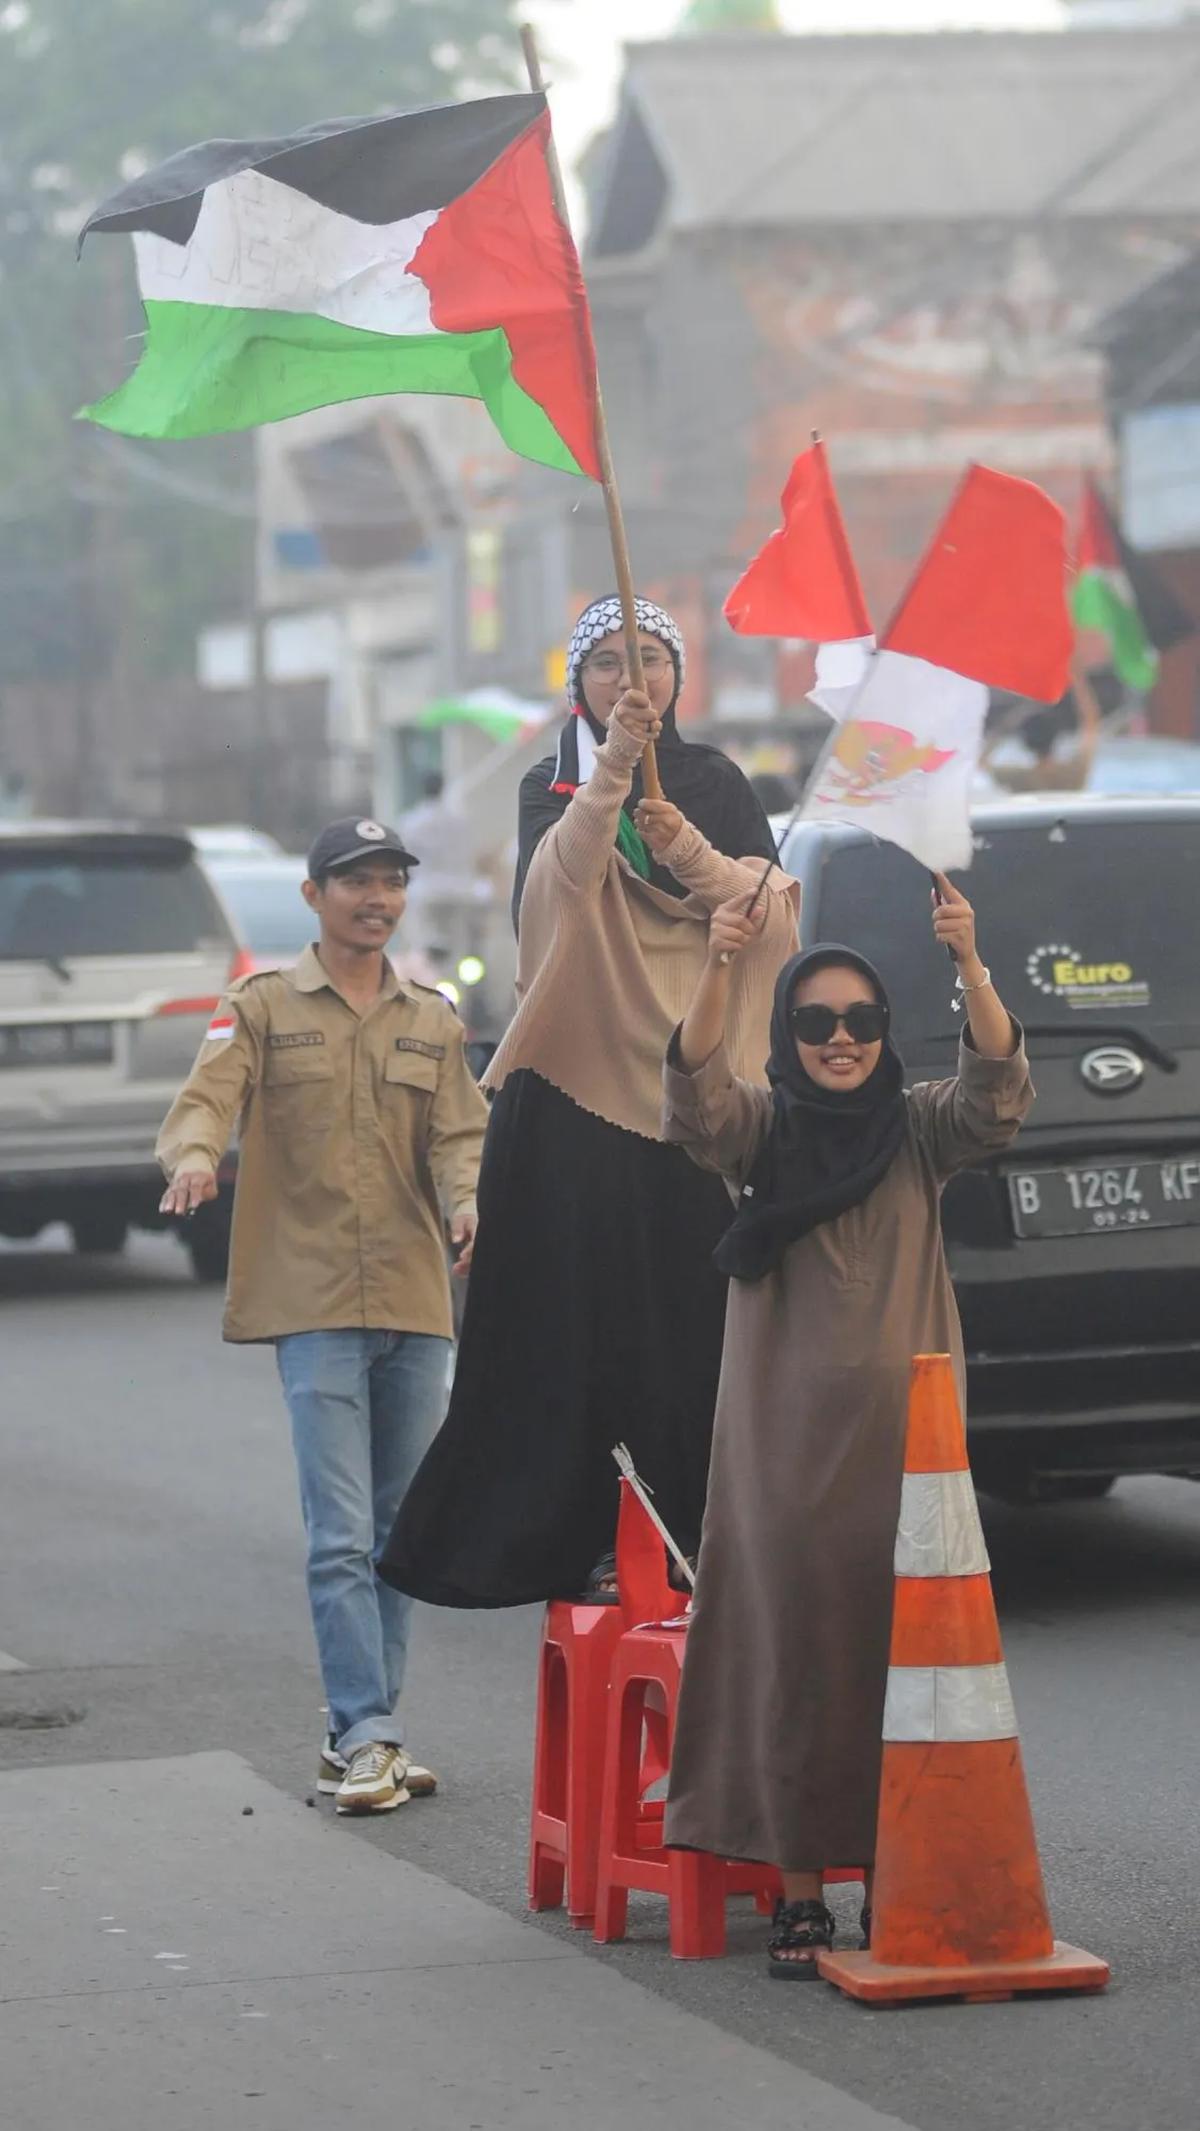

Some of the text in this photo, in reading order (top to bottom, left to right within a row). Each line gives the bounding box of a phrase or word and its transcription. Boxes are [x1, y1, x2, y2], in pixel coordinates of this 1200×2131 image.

[1053, 960, 1132, 985] Euro
[1016, 1175, 1041, 1215] B
[1065, 1167, 1143, 1210] 1264
